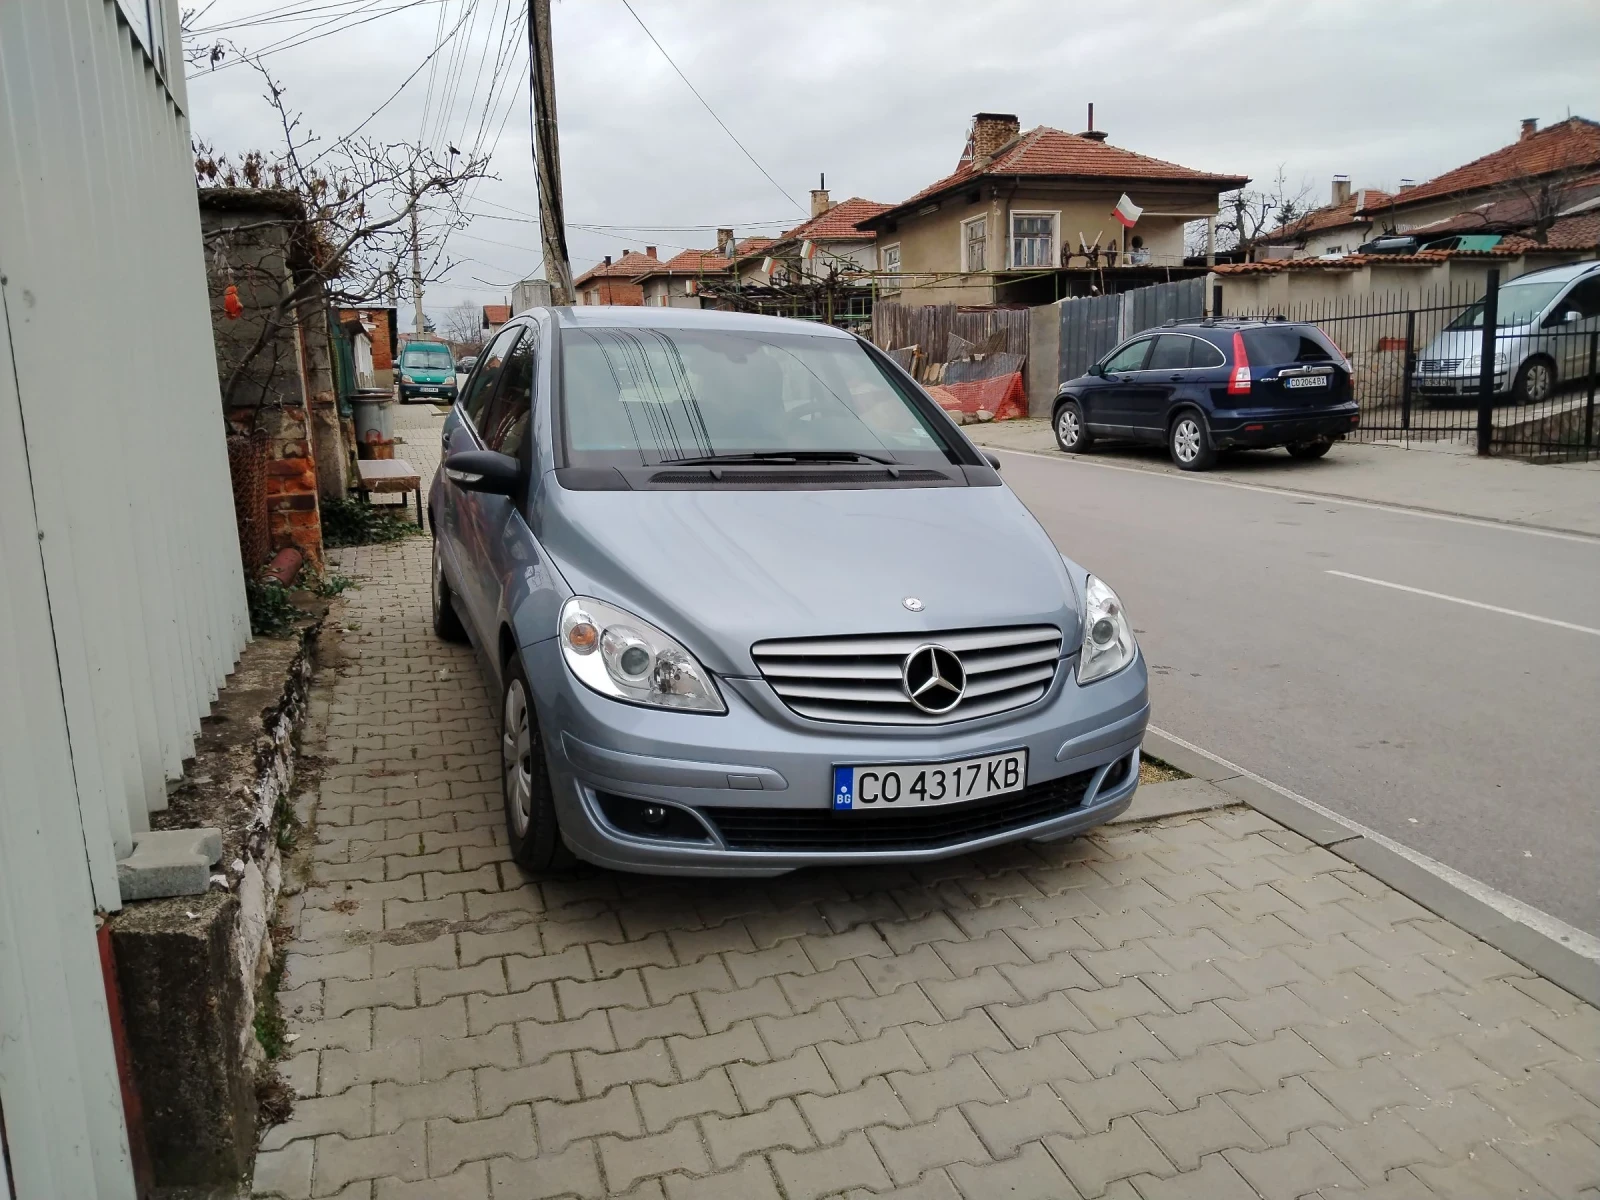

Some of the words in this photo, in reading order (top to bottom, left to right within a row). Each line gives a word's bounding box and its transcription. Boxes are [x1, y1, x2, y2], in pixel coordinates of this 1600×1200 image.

[858, 771, 901, 804] CO
[909, 763, 982, 802] 4317
[986, 756, 1020, 792] KB
[836, 793, 851, 804] BG
